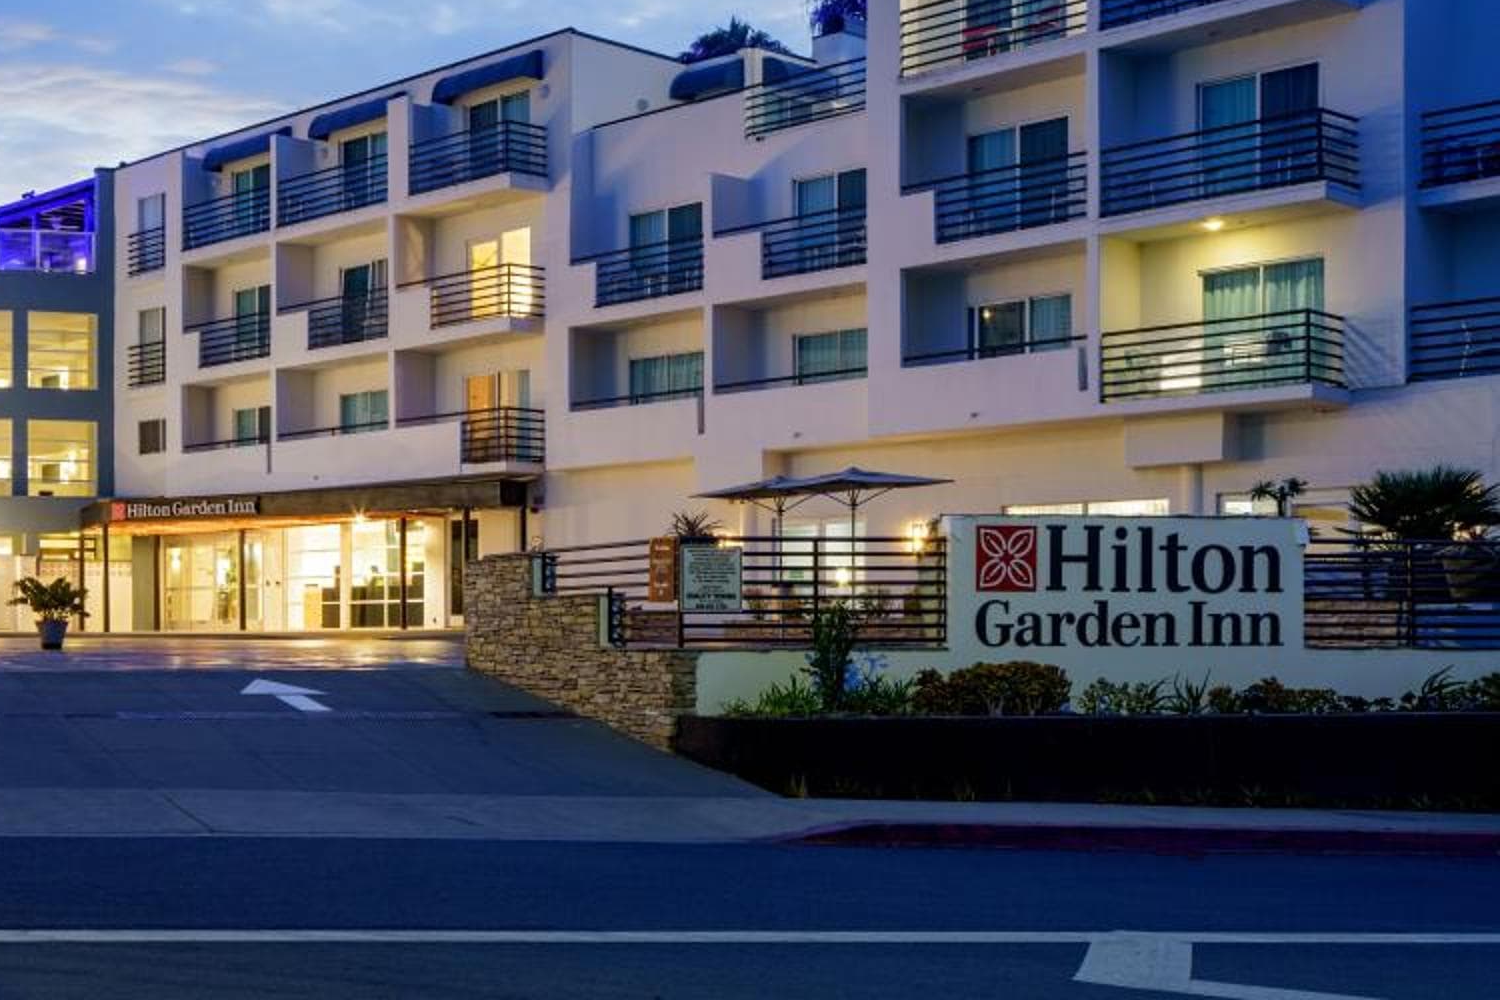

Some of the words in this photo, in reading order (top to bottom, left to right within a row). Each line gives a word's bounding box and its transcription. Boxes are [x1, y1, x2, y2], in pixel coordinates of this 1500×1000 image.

[127, 502, 171, 518] Hilton
[172, 501, 226, 516] Garden
[227, 499, 256, 513] Inn
[1045, 524, 1285, 594] Hilton
[975, 599, 1180, 648] Garden
[1187, 600, 1285, 648] Inn
